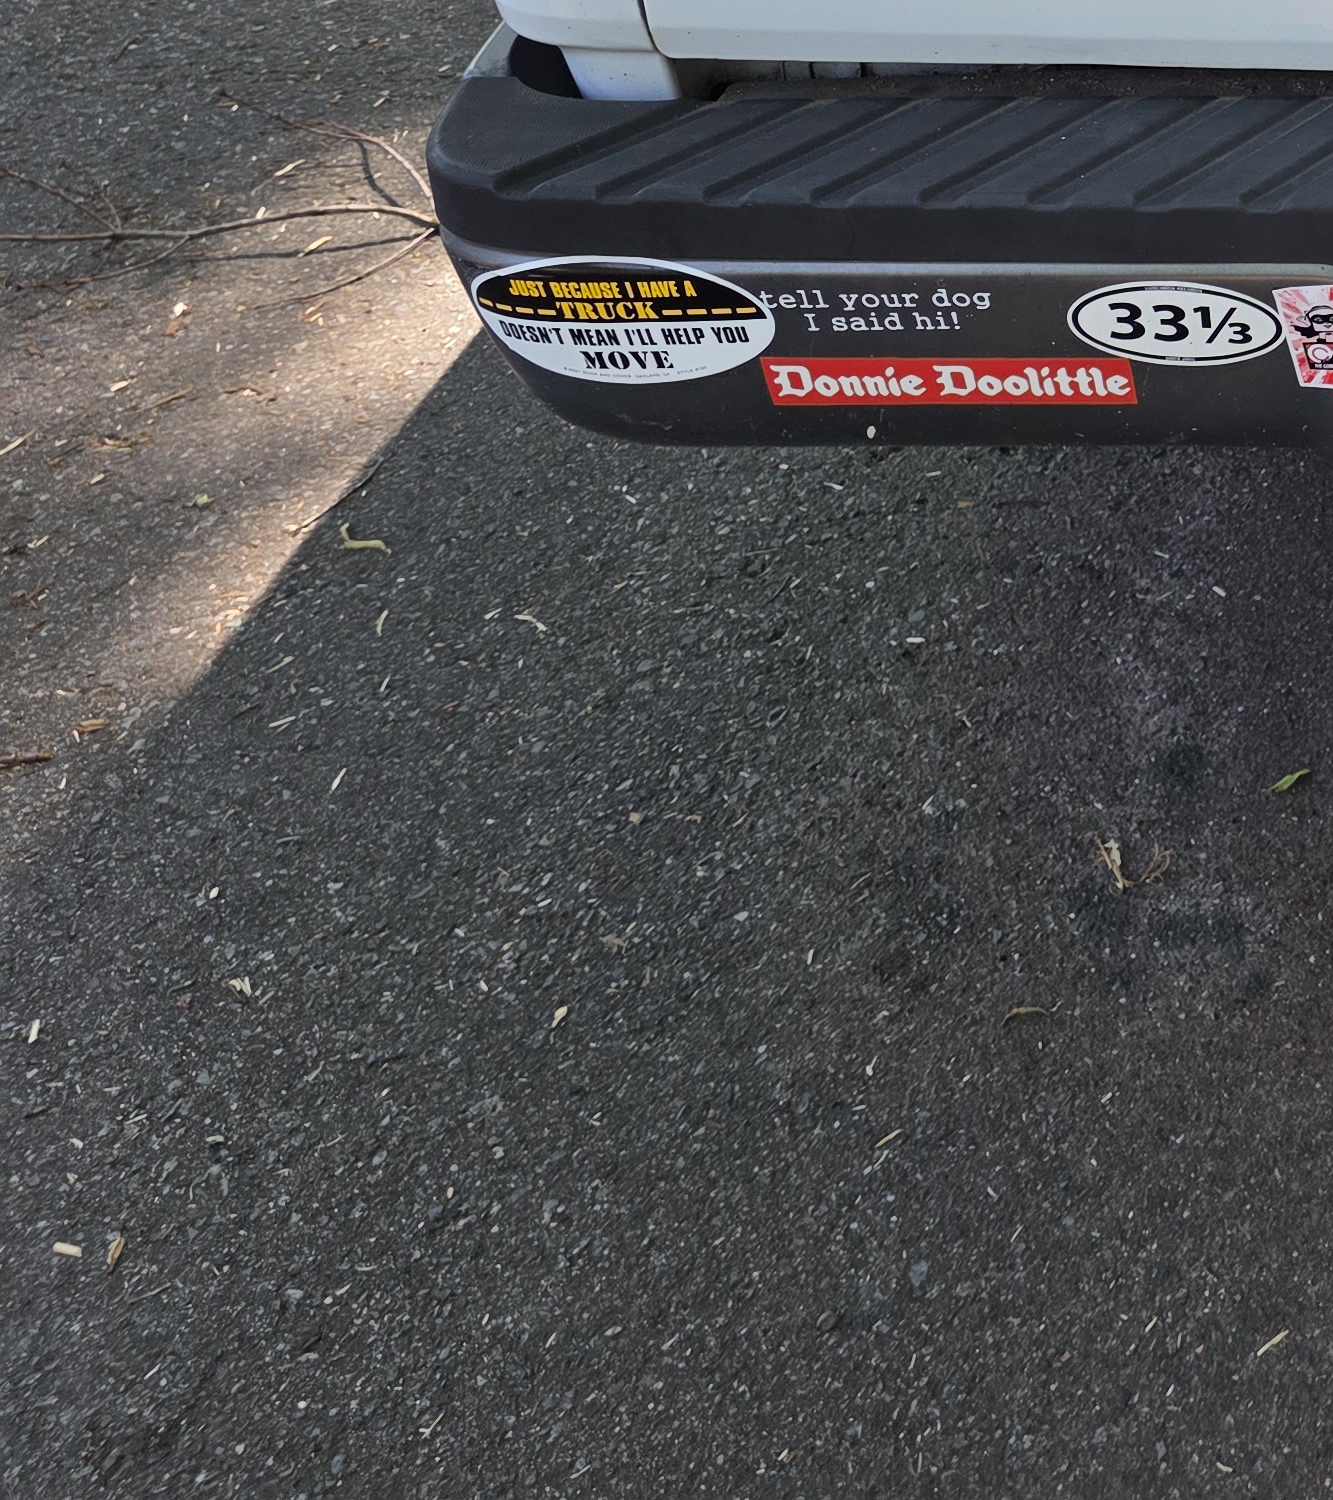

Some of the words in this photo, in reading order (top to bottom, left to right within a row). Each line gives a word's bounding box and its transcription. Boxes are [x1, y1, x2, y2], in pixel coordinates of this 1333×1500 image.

[508, 279, 547, 298] JUST
[549, 281, 623, 299] BECAUSE
[625, 282, 635, 298] I
[637, 280, 680, 298] HAVE
[683, 280, 697, 297] A
[555, 301, 660, 320] TRUCK
[759, 289, 830, 310] tell
[839, 292, 920, 312] your
[931, 289, 992, 311] dog
[806, 313, 821, 332] I
[833, 311, 904, 332] said
[912, 311, 961, 331] hi!
[498, 319, 565, 346] DOESN'T
[568, 328, 620, 346] MEAN
[625, 328, 658, 346] I'LL
[660, 327, 706, 345] HELP
[710, 326, 751, 344] YOU
[579, 350, 675, 370] MOVE
[769, 364, 927, 398] Donnie
[932, 364, 1132, 397] Doolittle
